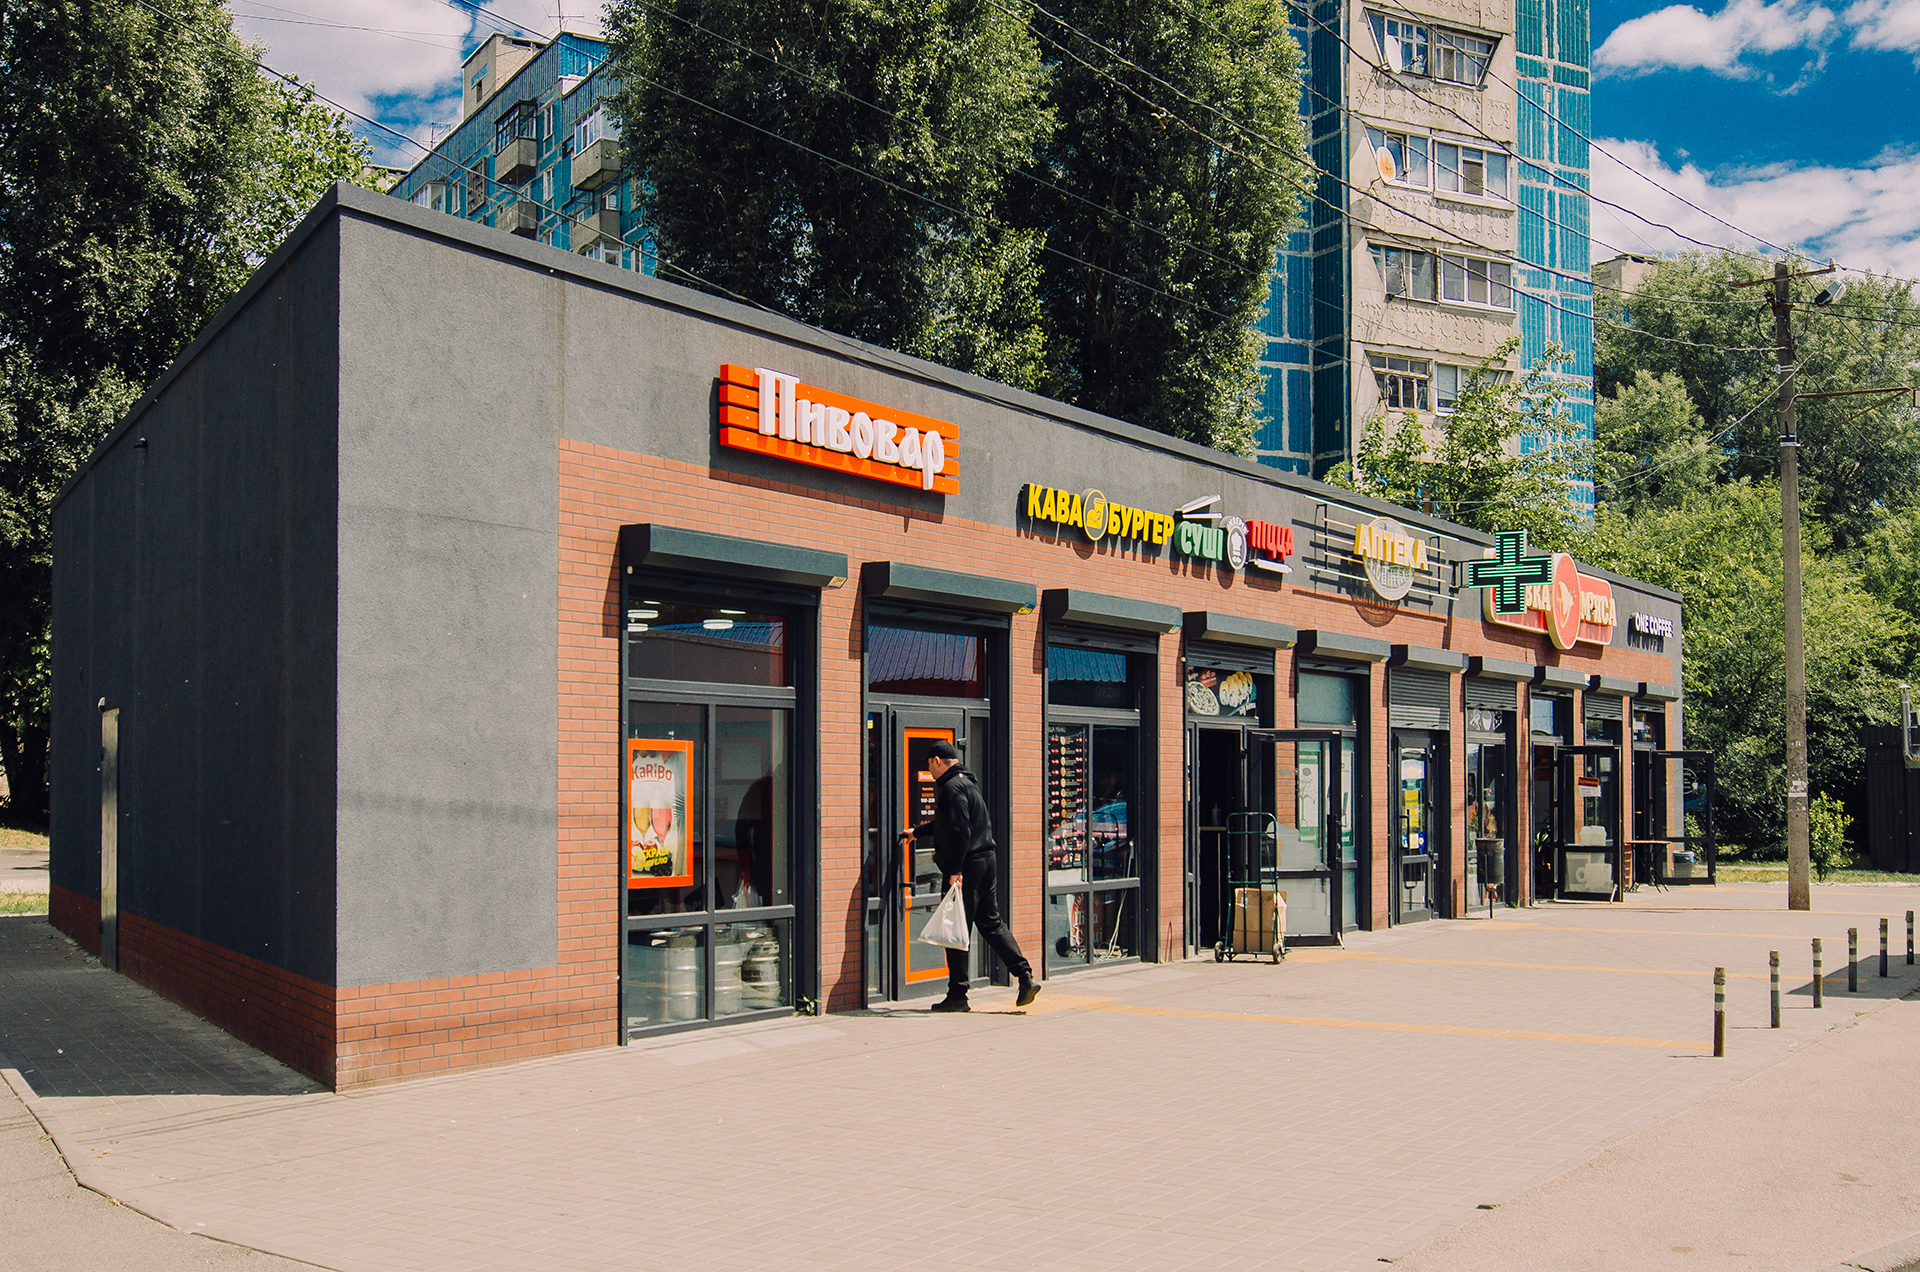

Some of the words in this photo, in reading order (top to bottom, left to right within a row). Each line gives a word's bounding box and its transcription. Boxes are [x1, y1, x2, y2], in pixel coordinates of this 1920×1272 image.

[754, 367, 945, 490] Пивовар
[1028, 483, 1083, 529] КАВА
[1108, 502, 1175, 546] БУРГЕР
[1177, 520, 1224, 562] СУШІ
[1247, 519, 1294, 561] ПІЦЦА
[1354, 523, 1429, 571] АПТЕКА
[1635, 612, 1650, 633] ONE
[1650, 616, 1674, 639] COFFEE
